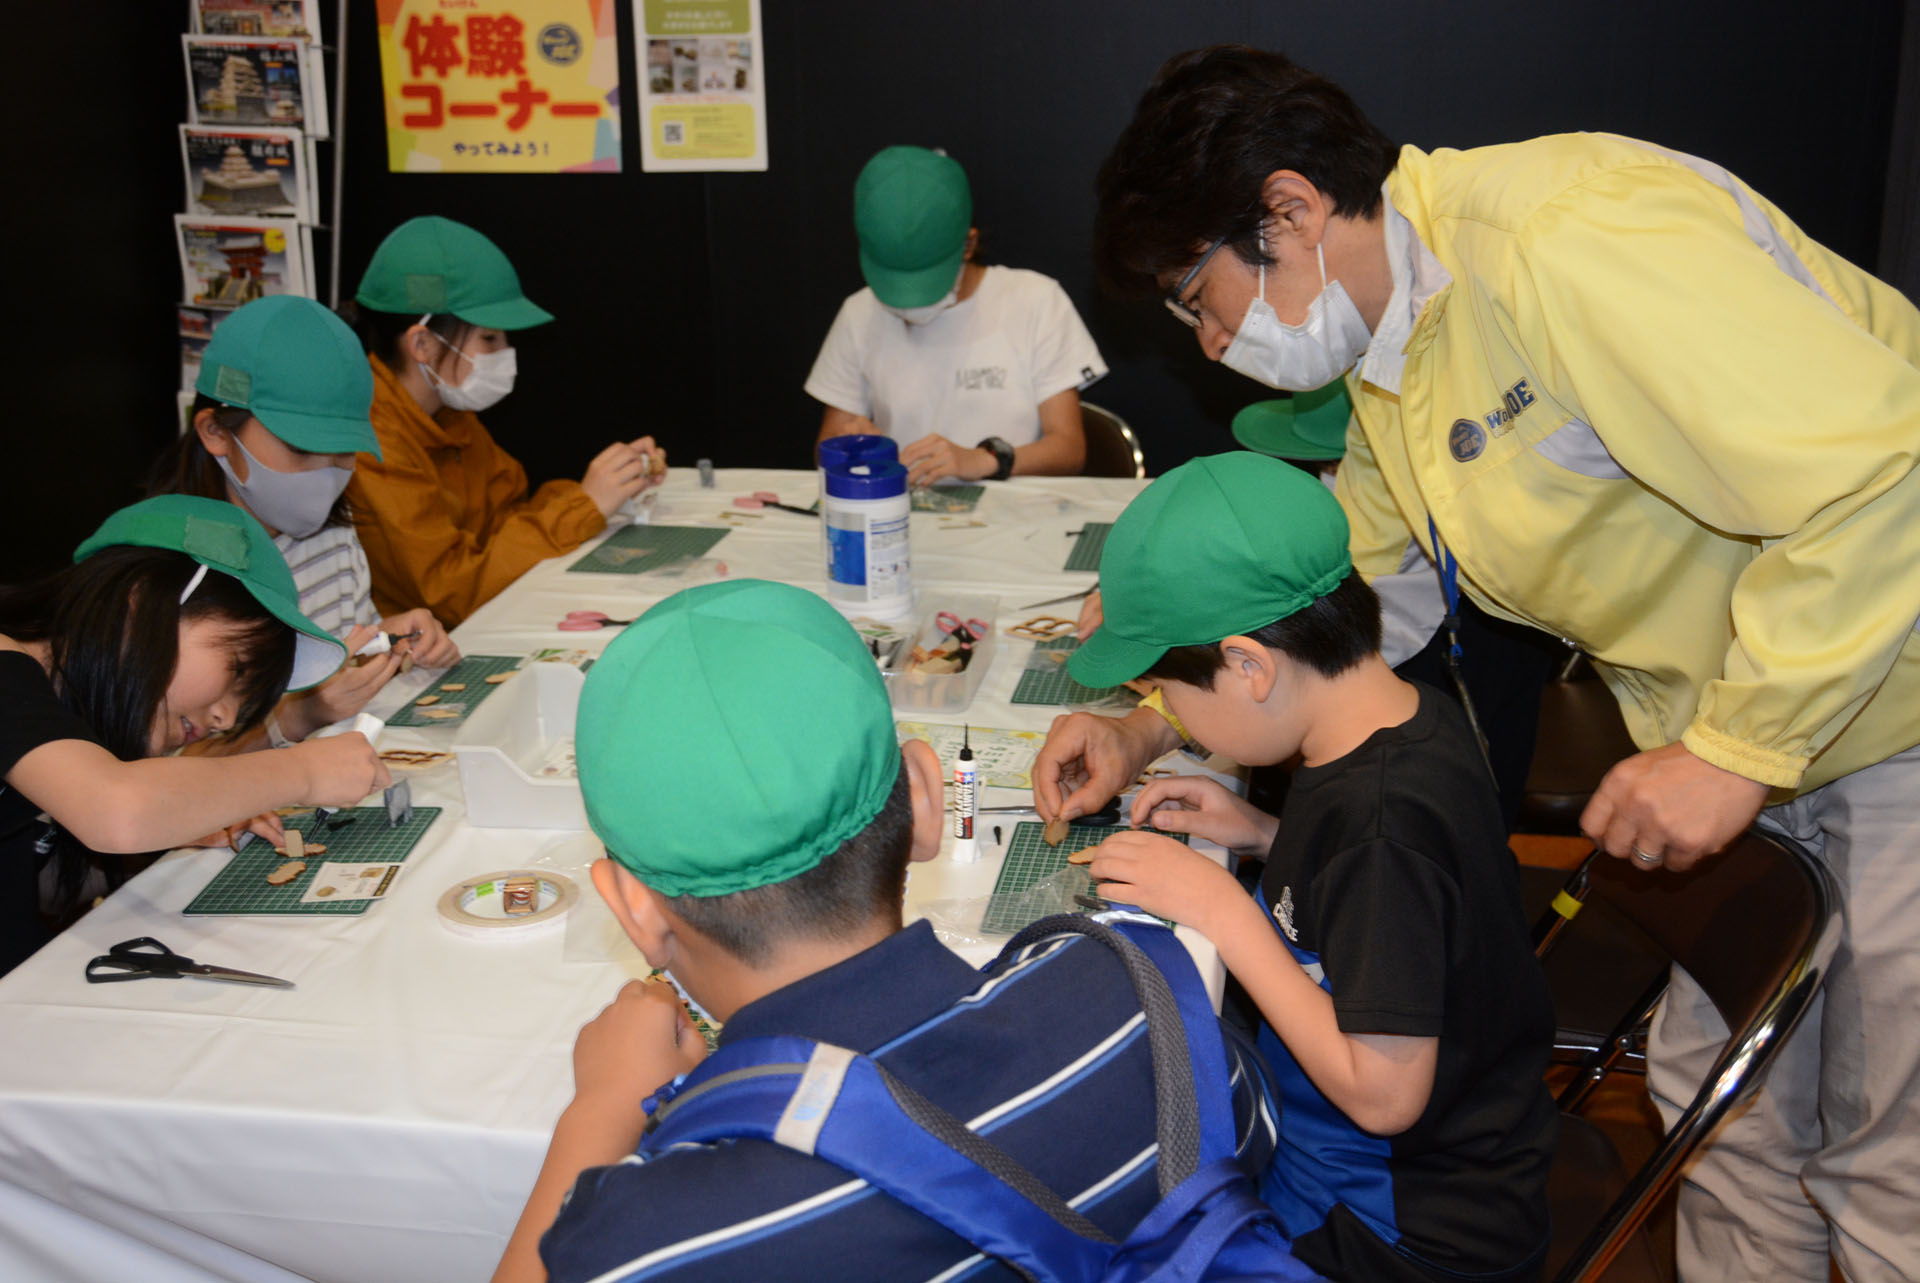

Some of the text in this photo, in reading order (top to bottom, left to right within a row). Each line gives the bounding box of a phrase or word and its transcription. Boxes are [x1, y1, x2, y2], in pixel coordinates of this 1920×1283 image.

[402, 13, 527, 78] 体験
[400, 79, 602, 131] コーナー
[452, 141, 550, 157] やってみよう！
[962, 782, 974, 818] TAMIYA
